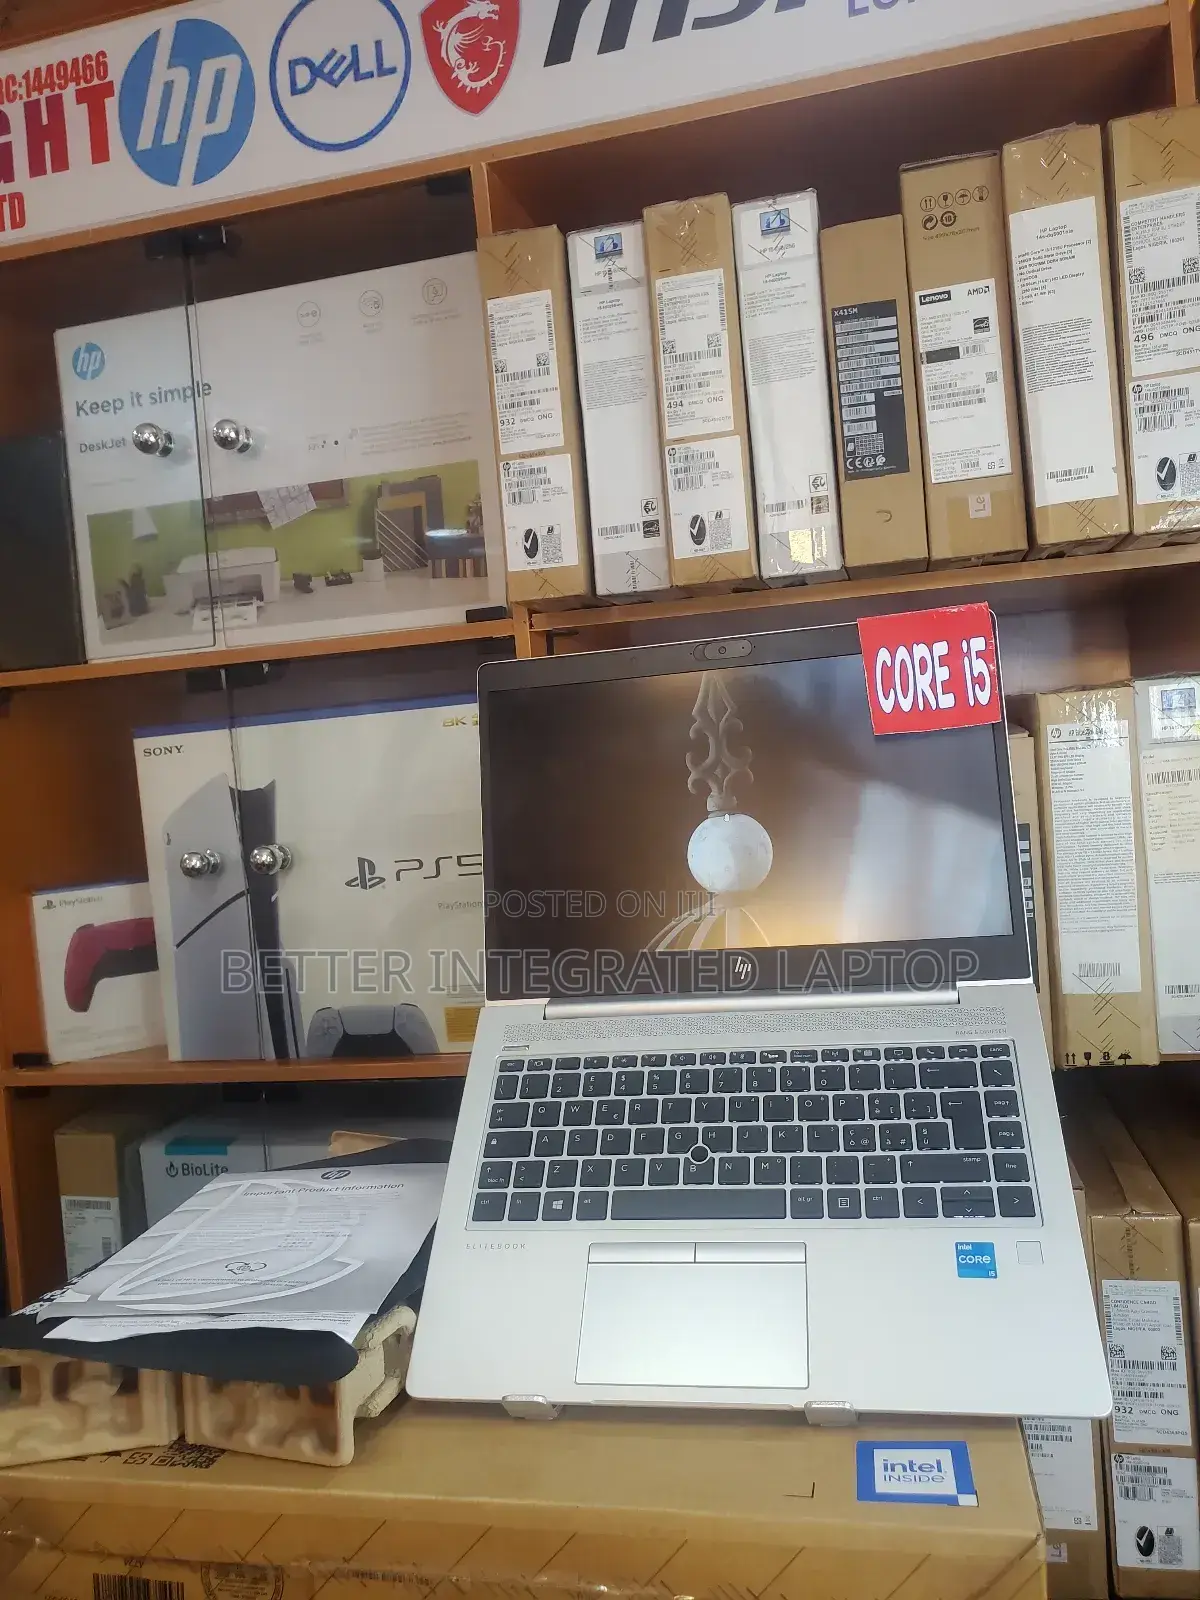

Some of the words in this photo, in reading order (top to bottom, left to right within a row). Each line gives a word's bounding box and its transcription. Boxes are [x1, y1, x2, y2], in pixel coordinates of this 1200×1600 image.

[287, 40, 399, 96] DELL
[137, 20, 242, 187] hp
[920, 292, 950, 304] Lenovo
[967, 286, 983, 297] AMD
[1134, 333, 1154, 343] 496
[78, 343, 102, 380] hp
[75, 398, 125, 417] Keep
[130, 390, 143, 408] it
[149, 380, 212, 405] simple
[666, 400, 684, 410] 494
[707, 396, 724, 404] ONG
[500, 418, 516, 427] 932
[537, 412, 553, 421] ONG
[79, 437, 126, 453] DeskJet
[875, 640, 956, 714] CORE
[961, 636, 991, 707] i5
[143, 745, 184, 757] SONY
[394, 853, 482, 881] PS5
[786, 1079, 792, 1087] 9
[634, 1103, 641, 1111] R
[667, 1102, 673, 1110] T
[839, 1099, 846, 1107] P
[542, 1135, 549, 1143] A
[575, 1134, 581, 1142] S
[607, 1133, 614, 1141] D
[675, 1132, 682, 1140] G
[708, 1131, 716, 1139] H
[743, 1131, 749, 1139] J
[778, 1130, 786, 1138] K
[181, 1162, 229, 1177] BioLite
[553, 1165, 560, 1173] Z
[587, 1165, 594, 1173] X
[621, 1164, 628, 1172] C
[655, 1163, 663, 1171] V
[690, 1164, 697, 1172] B
[725, 1162, 732, 1170] N
[761, 1162, 769, 1170] M
[243, 1188, 296, 1197] Important
[298, 1186, 339, 1194] Product
[341, 1183, 405, 1192] Information
[1114, 1405, 1134, 1415] 932
[882, 1458, 943, 1473] intel
